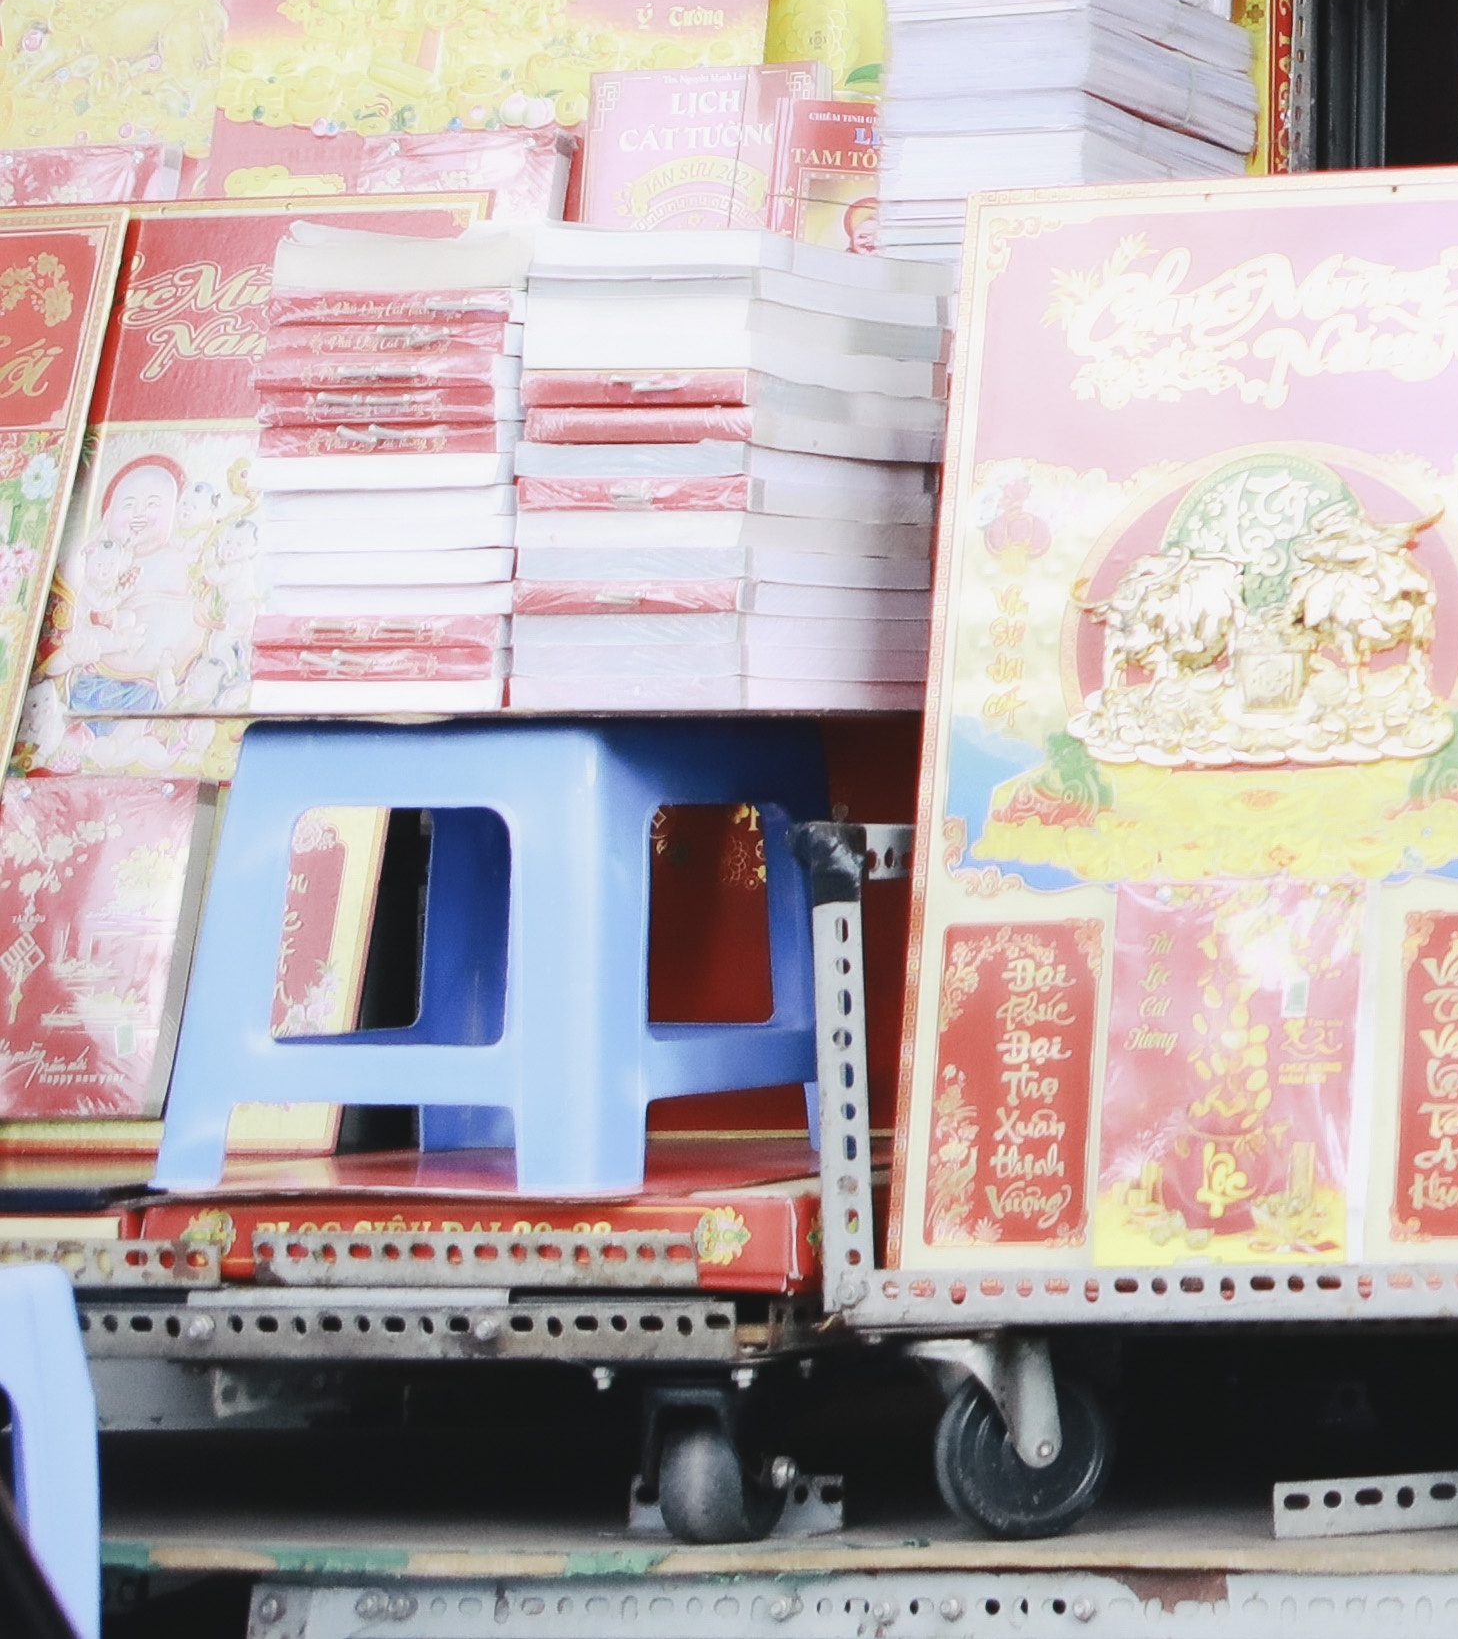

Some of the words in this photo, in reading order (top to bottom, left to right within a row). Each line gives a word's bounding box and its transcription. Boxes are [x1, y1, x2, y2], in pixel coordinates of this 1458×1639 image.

[668, 4, 725, 31] Tường
[670, 89, 742, 119] LỊCH
[619, 123, 680, 154] CÁT
[791, 147, 842, 166] TAM
[1001, 958, 1077, 993] Đại
[996, 991, 1077, 1031] Phúc
[996, 1030, 1074, 1066] Đại
[1000, 1062, 1060, 1108] Thọ
[993, 1105, 1066, 1145] Xuân
[984, 1179, 1073, 1230] Vượng
